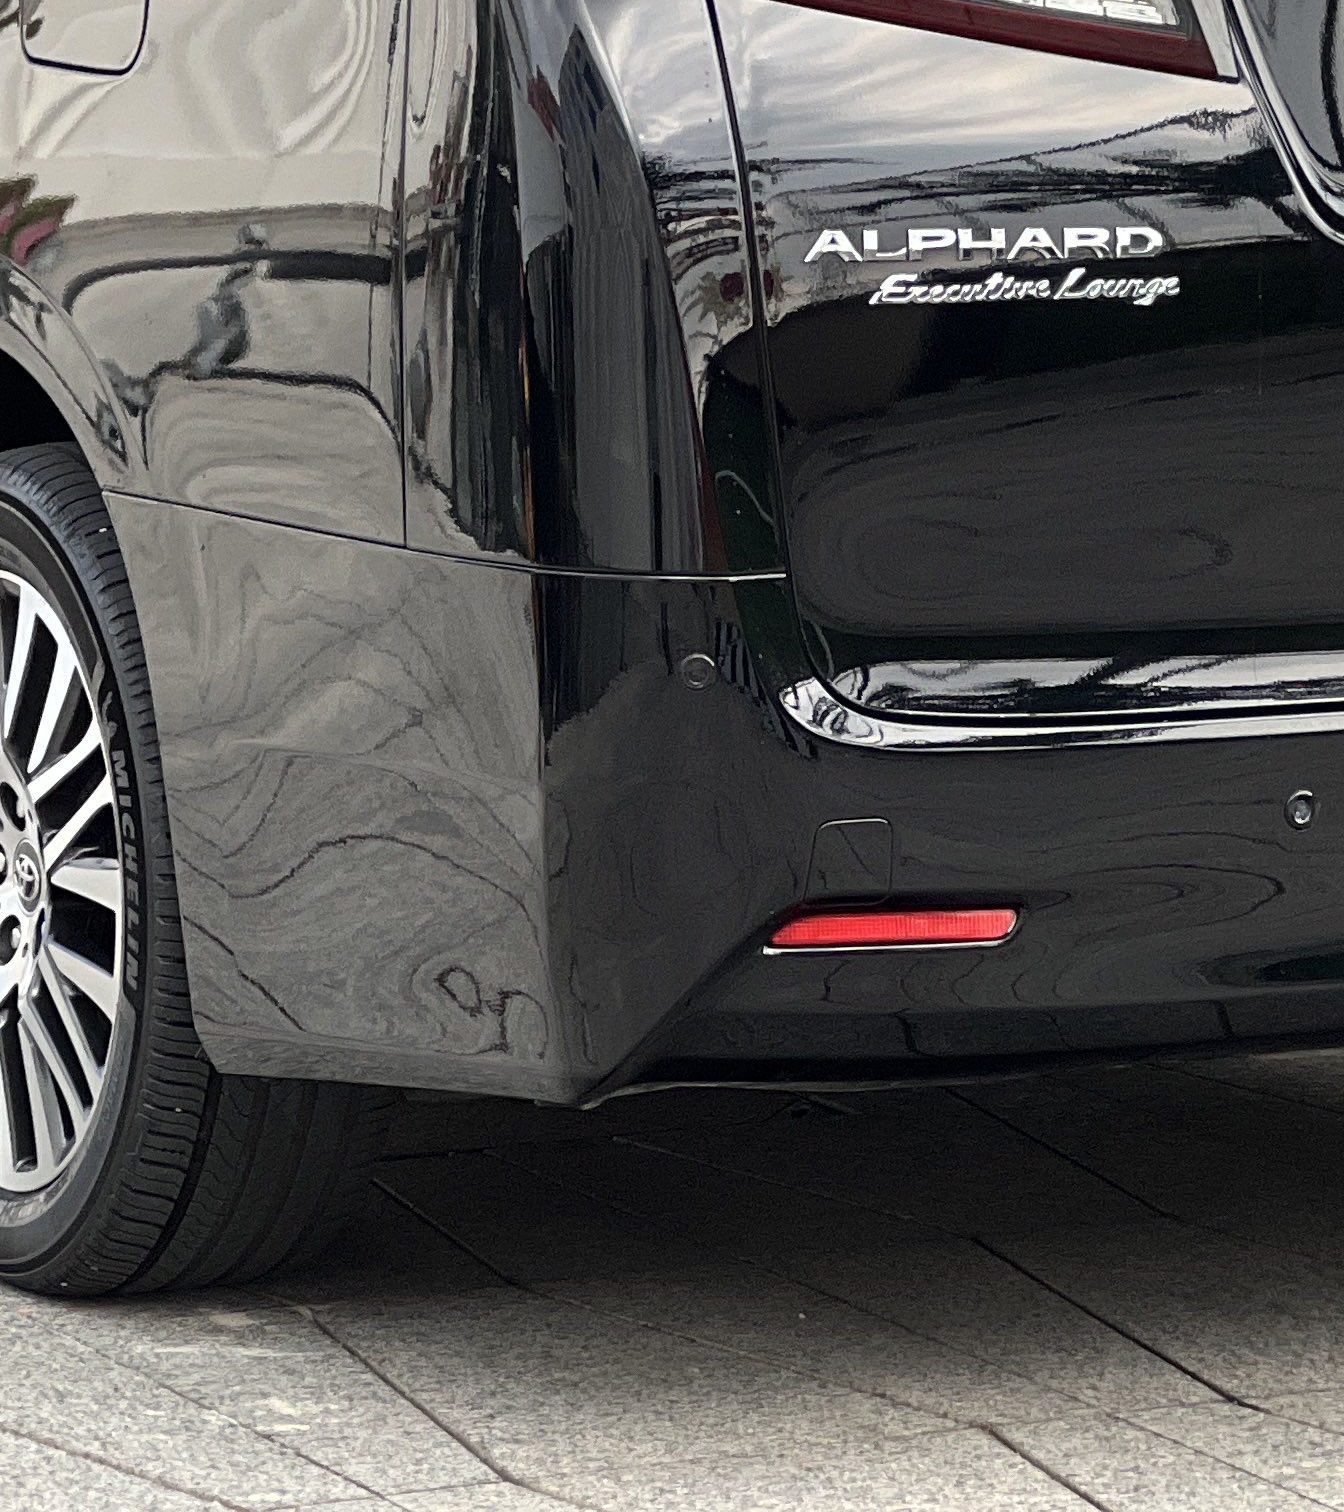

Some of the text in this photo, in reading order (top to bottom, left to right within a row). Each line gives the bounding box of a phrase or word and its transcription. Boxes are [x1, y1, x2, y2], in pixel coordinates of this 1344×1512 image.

[803, 226, 1164, 263] ALPHARD
[868, 267, 1181, 306] Executive Lounge
[111, 749, 140, 991] MICHELIN
